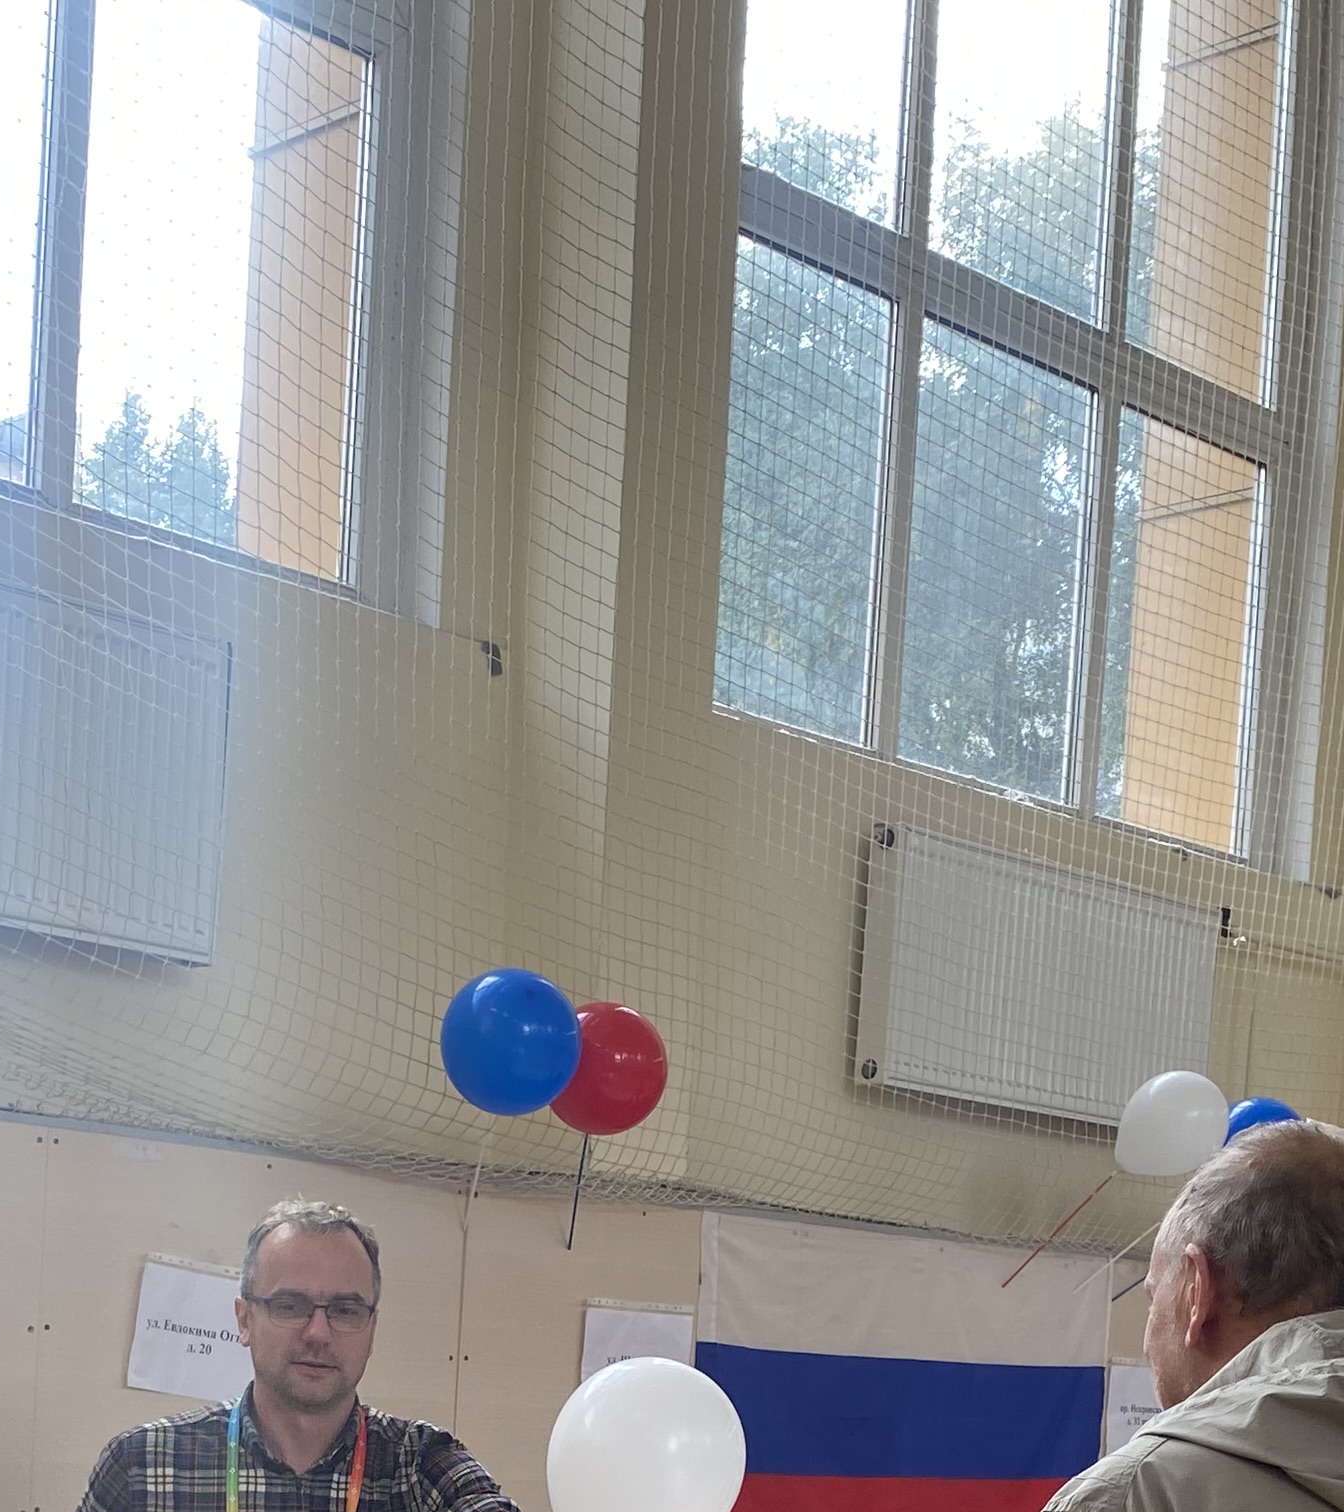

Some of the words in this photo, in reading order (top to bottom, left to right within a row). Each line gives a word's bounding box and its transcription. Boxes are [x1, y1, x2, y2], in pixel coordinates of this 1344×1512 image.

[145, 1318, 161, 1331] ул.
[163, 1319, 217, 1340] Евдокима
[198, 1343, 213, 1356] 20
